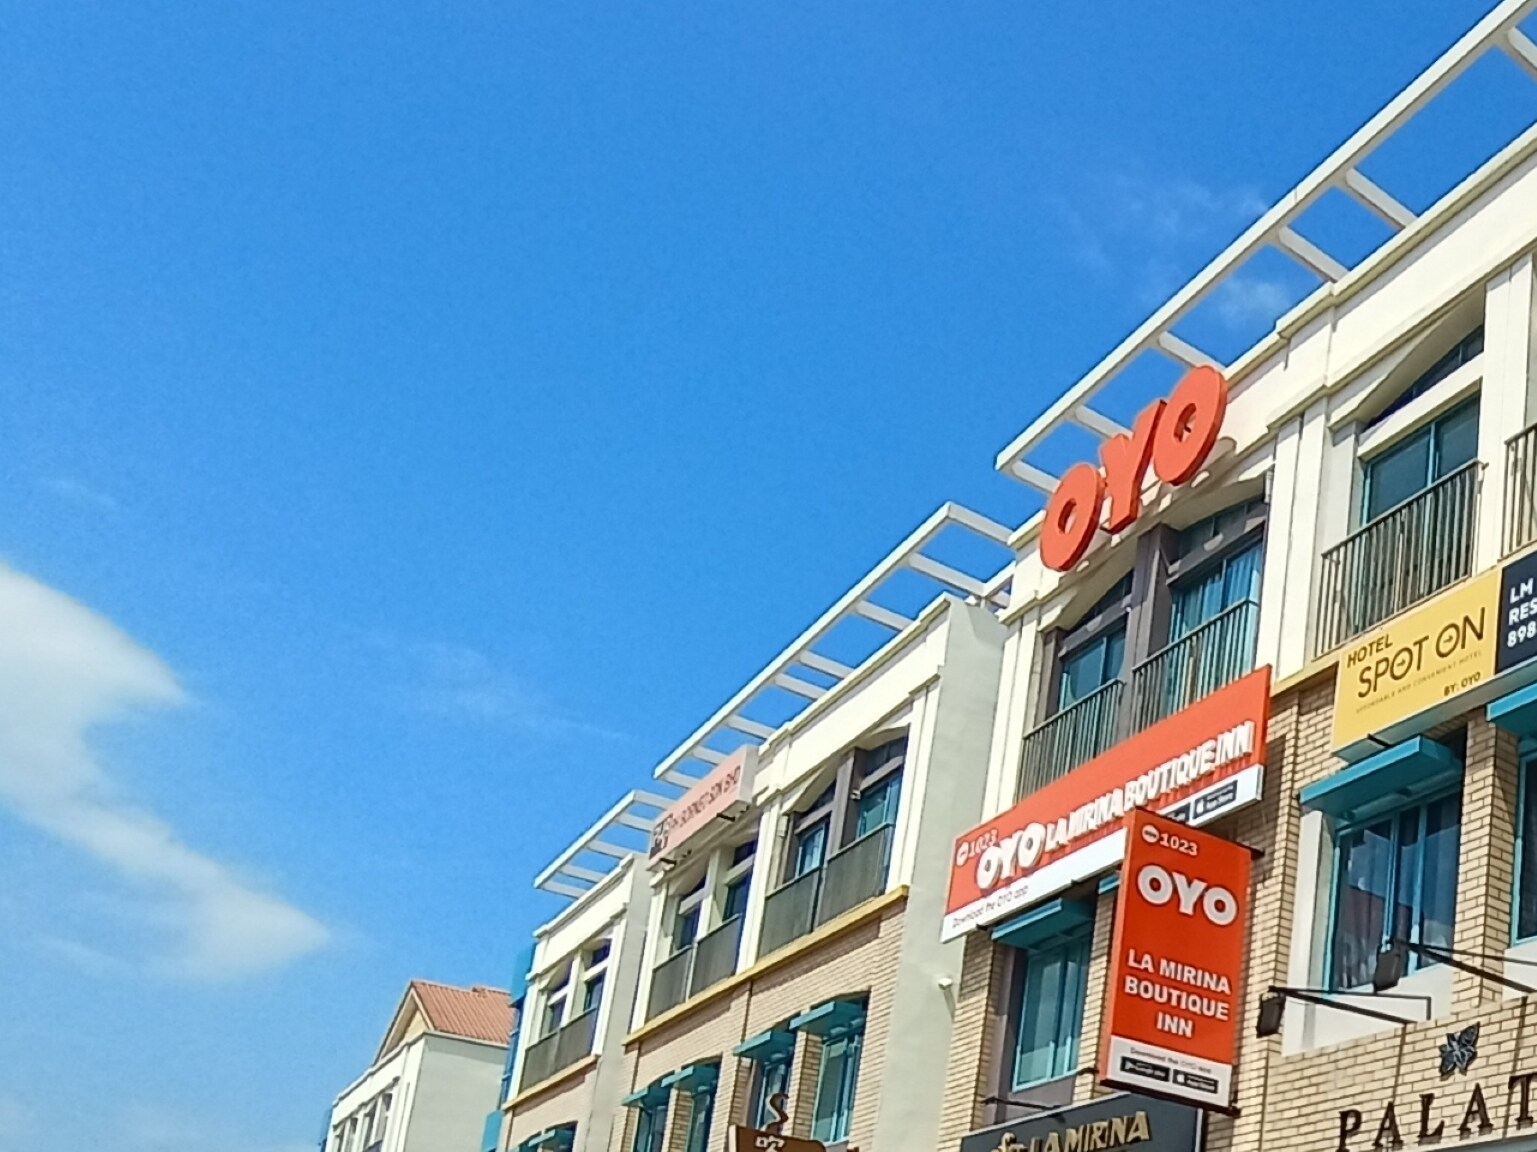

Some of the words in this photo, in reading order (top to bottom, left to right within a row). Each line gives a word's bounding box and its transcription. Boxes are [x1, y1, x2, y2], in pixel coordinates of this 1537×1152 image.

[1040, 365, 1228, 572] OYO
[1510, 577, 1534, 604] LM
[1347, 633, 1393, 668] HOTEL
[1357, 635, 1430, 698] SPOT
[1436, 606, 1486, 658] ON
[1461, 671, 1481, 688] OYO
[976, 822, 1047, 889] OYO
[1124, 738, 1216, 812] BOUTIQUE
[1214, 720, 1256, 766] INN
[1160, 833, 1198, 856] 1023
[1138, 864, 1238, 926] OYO
[1128, 948, 1154, 973] LA
[1159, 958, 1232, 995] MIRINA
[1124, 975, 1229, 1021] BOUTIQUE
[1156, 1011, 1194, 1038] INN
